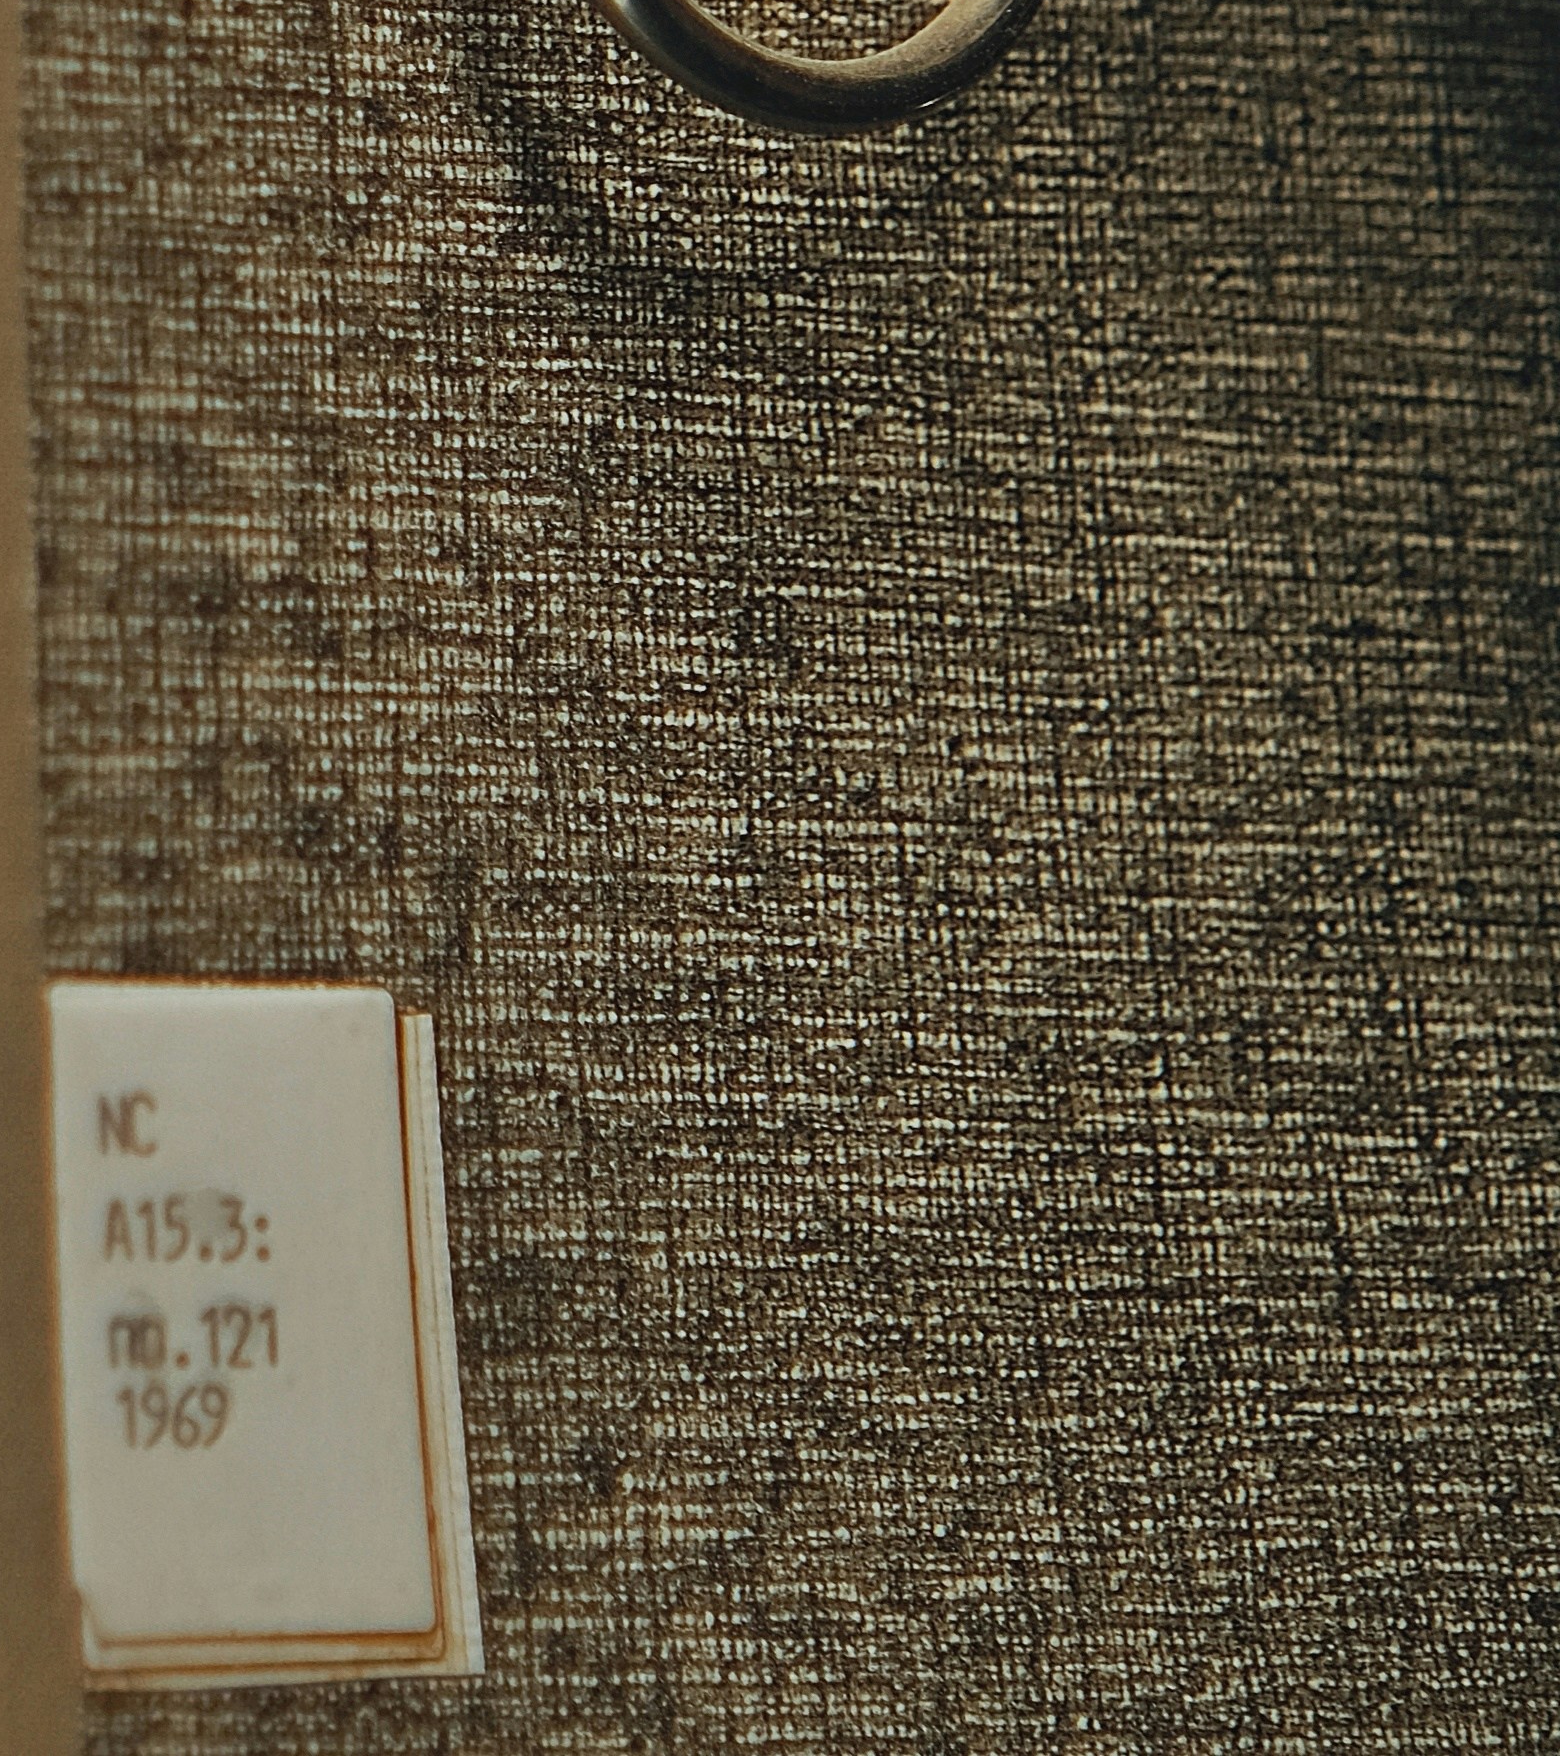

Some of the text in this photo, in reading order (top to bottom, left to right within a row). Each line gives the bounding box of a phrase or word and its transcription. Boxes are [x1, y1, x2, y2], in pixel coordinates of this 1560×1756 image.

[96, 1090, 158, 1158] NC
[103, 1194, 272, 1265] A15.3:
[117, 1384, 231, 1450] 1969
